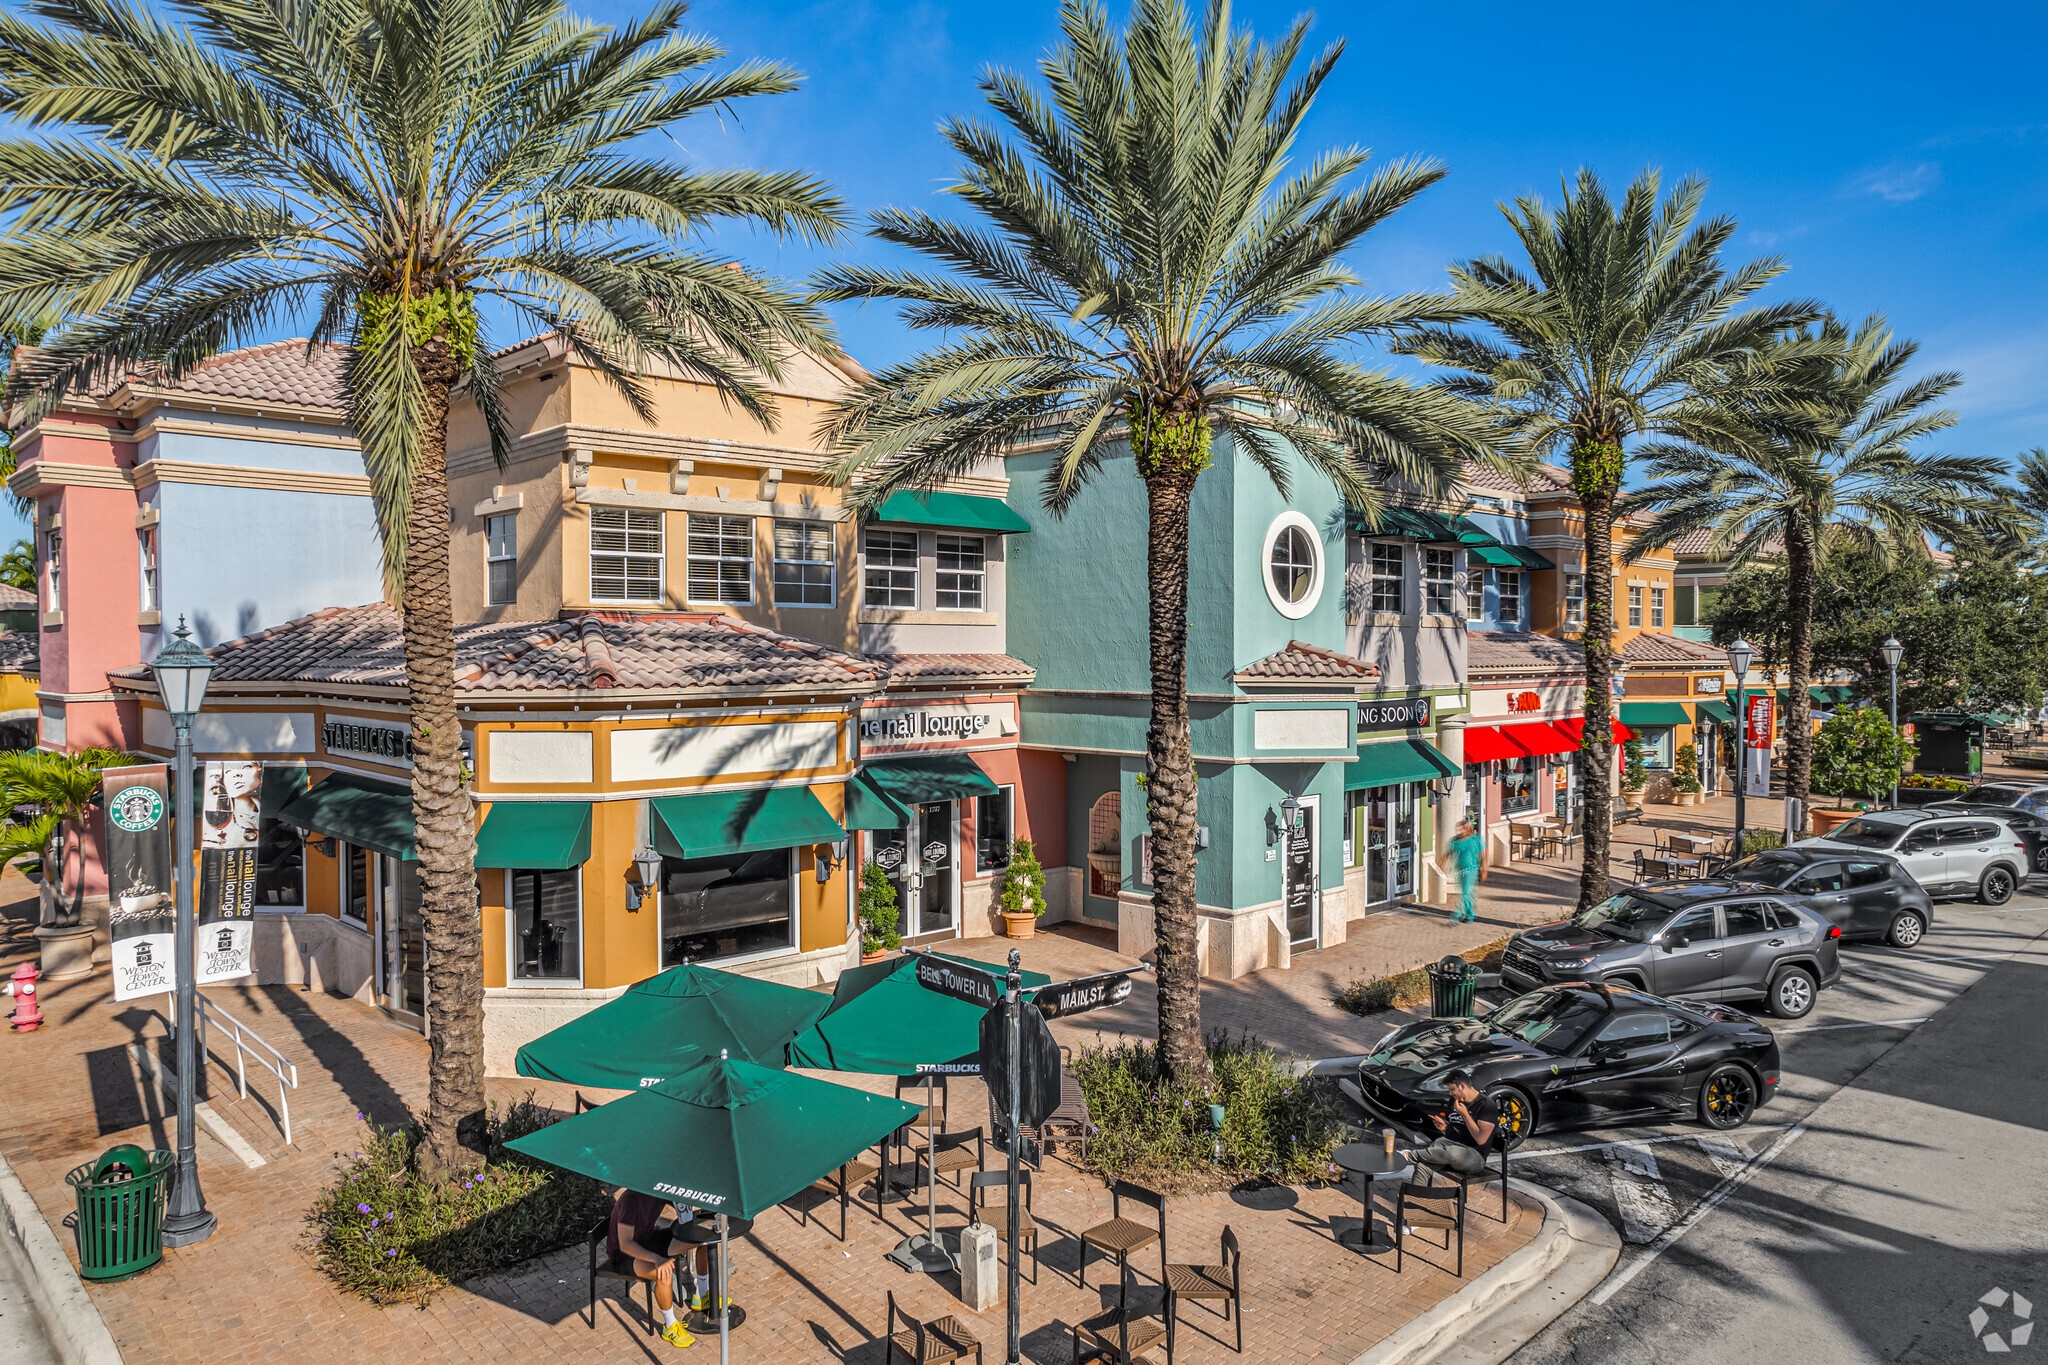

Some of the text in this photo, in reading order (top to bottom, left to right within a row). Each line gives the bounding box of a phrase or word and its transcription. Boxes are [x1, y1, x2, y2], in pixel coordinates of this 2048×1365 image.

[886, 712, 918, 735] nail
[925, 712, 984, 735] lounge
[1357, 706, 1414, 724] ING SOON
[1752, 698, 1769, 735] PANNA
[321, 722, 396, 758] STARBUCKS
[113, 788, 160, 810] STARBUCKS
[119, 816, 156, 830] COFFEE
[208, 862, 219, 883] nail
[203, 948, 244, 961] WESTON
[209, 958, 238, 967] TOWN
[120, 961, 166, 976] WESTON
[129, 970, 160, 983] TOWN
[205, 963, 246, 975] CENTER
[125, 976, 171, 992] CENTER
[920, 965, 942, 986] BELL
[942, 970, 976, 995] TOWER
[1060, 988, 1088, 1010] MAIN
[915, 1063, 981, 1074] STARBUCKS
